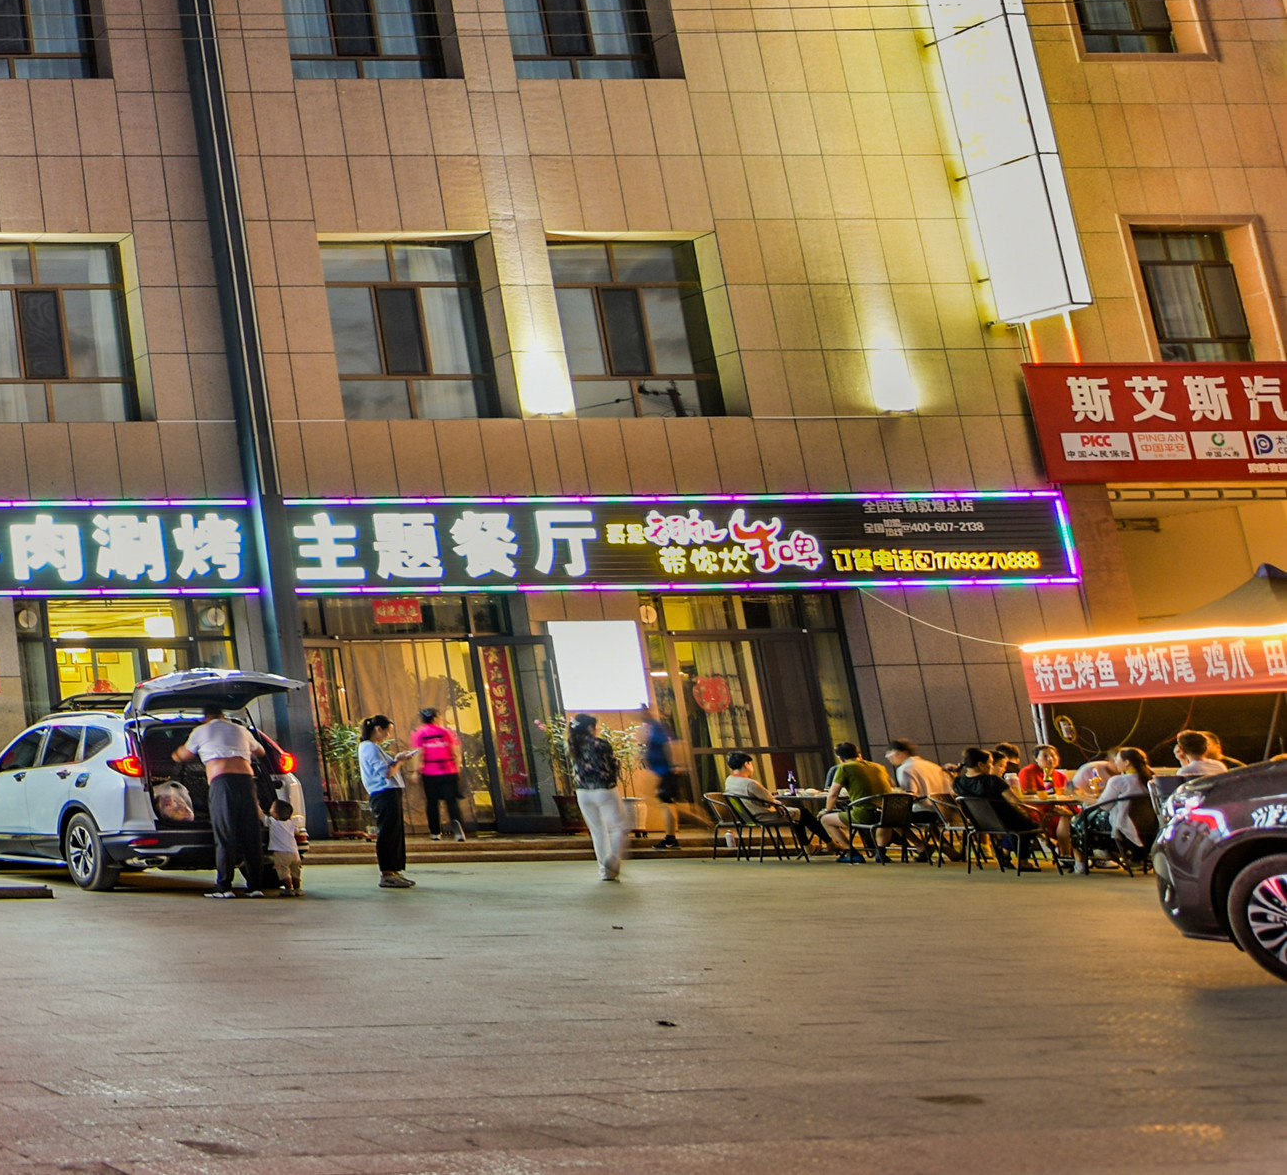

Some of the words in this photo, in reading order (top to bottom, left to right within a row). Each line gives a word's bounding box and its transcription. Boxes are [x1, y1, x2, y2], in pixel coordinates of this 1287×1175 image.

[1080, 435, 1112, 447] PICC
[1140, 443, 1187, 453] 中国平安
[1205, 450, 1240, 458] 中国人寿
[1067, 450, 1131, 459] 中国人民保险
[862, 500, 974, 514] 全国连锁敦煌总店
[911, 522, 985, 533] 400-607-2138
[293, 508, 597, 582] 主题餐厅
[831, 549, 915, 572] 订餐电话
[934, 551, 1041, 571] 17693270888
[1033, 651, 1120, 692] 特色烤鱼
[1125, 644, 1196, 686] 炒虾尾
[1202, 639, 1254, 681] 鸡爪
